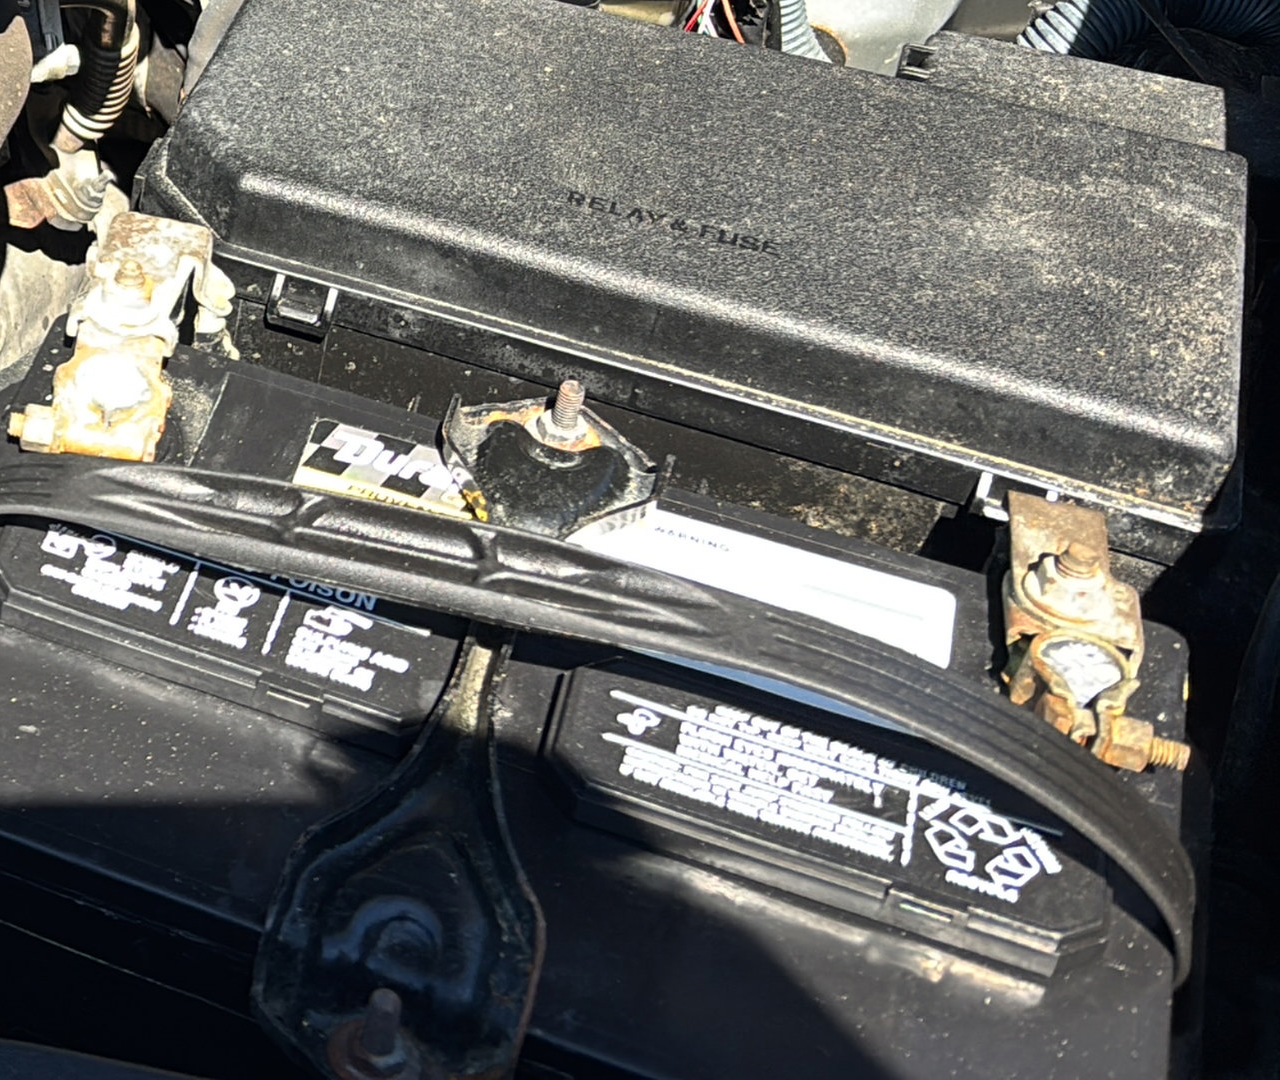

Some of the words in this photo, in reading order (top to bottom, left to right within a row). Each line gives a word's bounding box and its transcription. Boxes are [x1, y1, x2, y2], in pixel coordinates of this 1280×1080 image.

[567, 190, 667, 223] RELAY
[670, 219, 689, 233] &
[699, 224, 783, 257] FUSE
